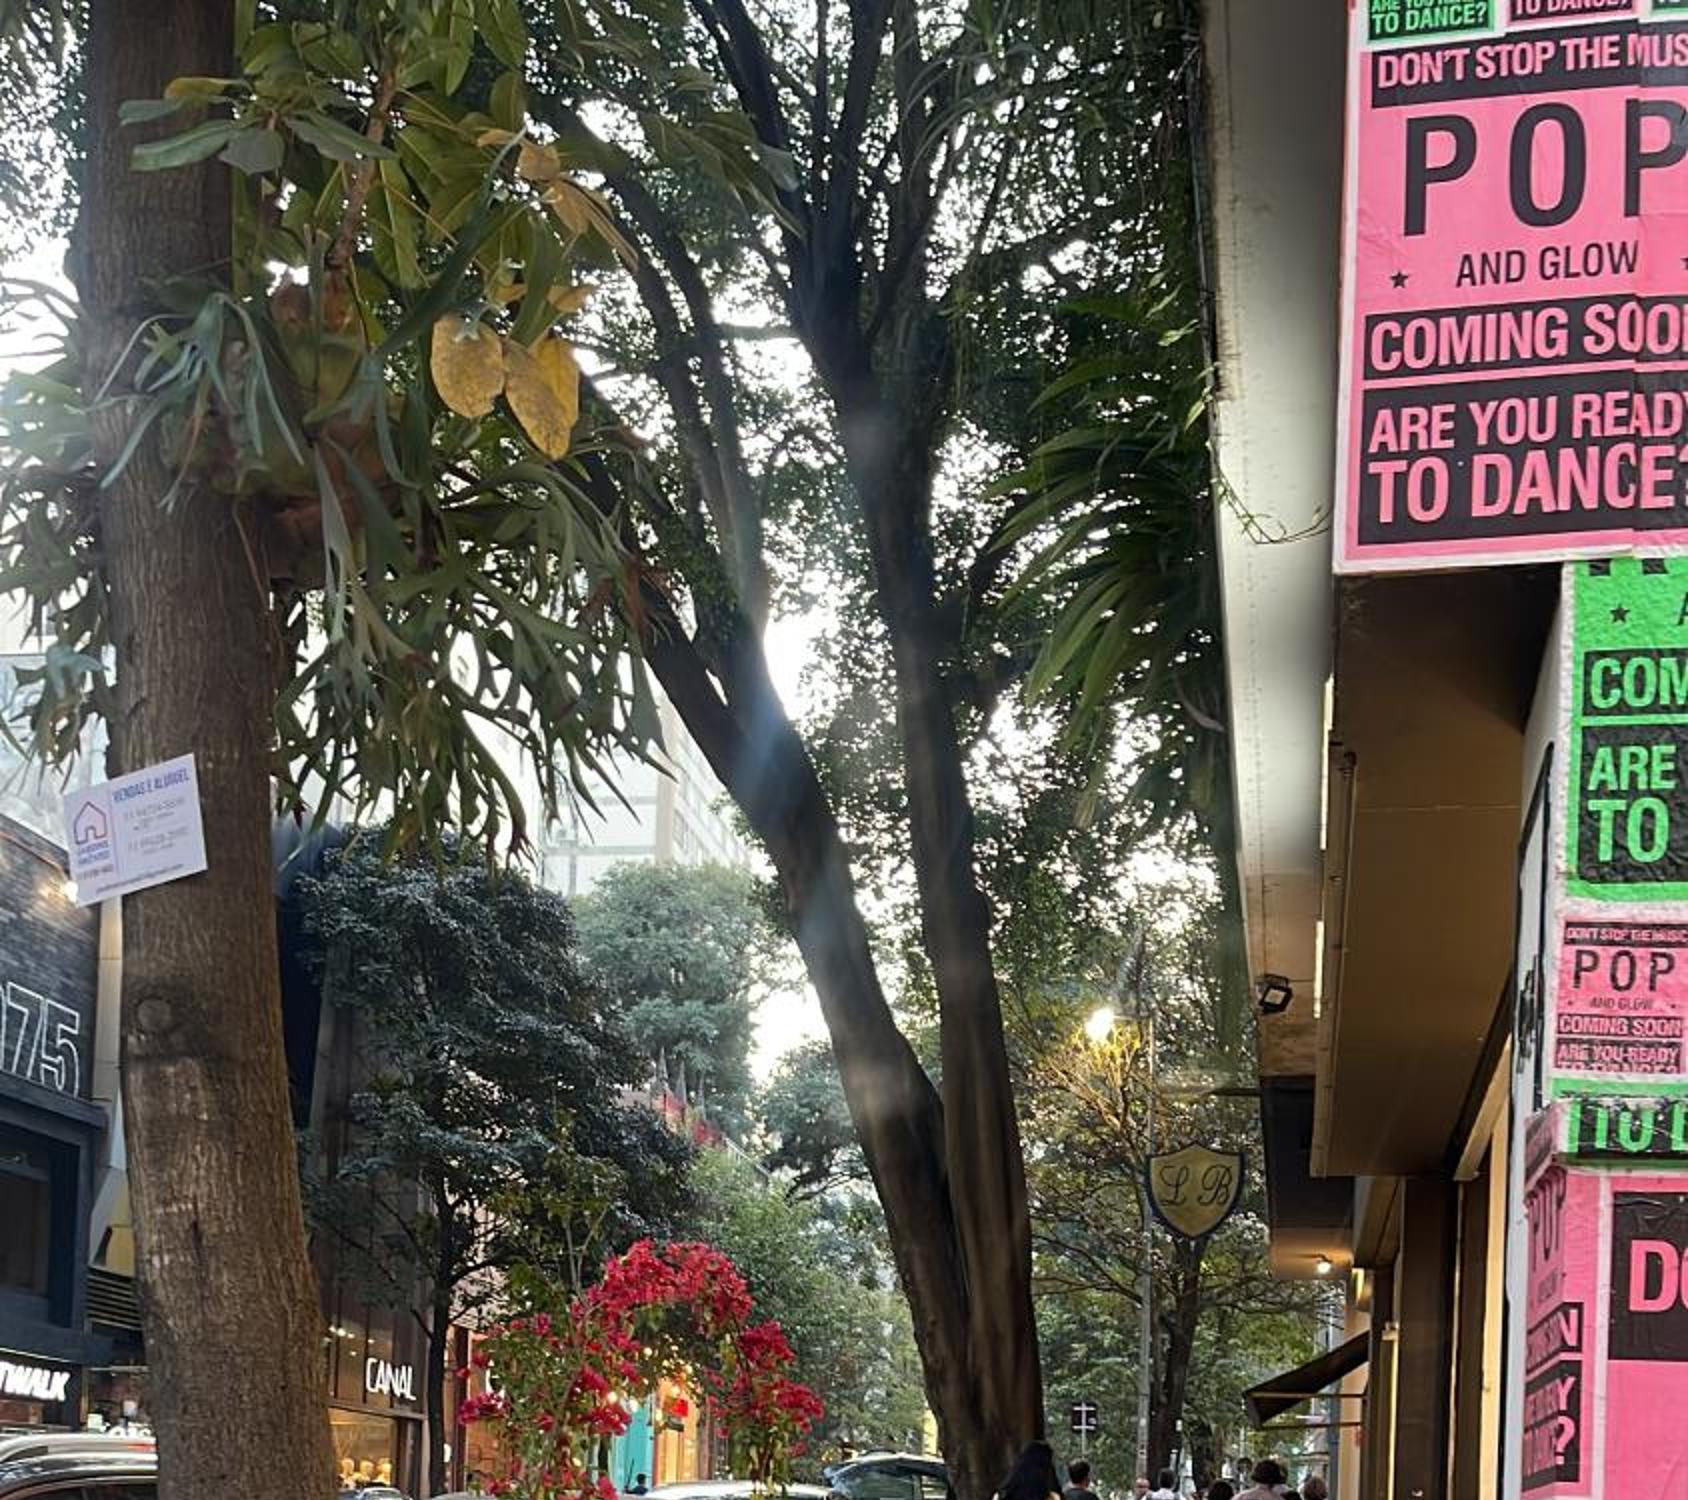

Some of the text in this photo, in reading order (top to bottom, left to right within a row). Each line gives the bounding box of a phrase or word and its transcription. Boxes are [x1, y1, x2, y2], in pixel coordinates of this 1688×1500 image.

[1371, 2, 1487, 35] TO DANCE?
[1377, 47, 1471, 88] DON'T
[1475, 41, 1555, 78] STOP
[1560, 34, 1621, 70] THE
[1403, 97, 1688, 237] POP
[1455, 240, 1639, 288] AND GLOW
[1370, 301, 1688, 371] COMING SOO
[1368, 391, 1688, 454] ARE YOU READ
[1367, 456, 1450, 524] TO
[1587, 745, 1677, 791] ARE
[1586, 796, 1670, 863] TO
[1571, 949, 1676, 992] POP
[0, 981, 80, 1100] 75
[1559, 1014, 1682, 1037] COMING SOON
[1628, 1238, 1688, 1313] D
[365, 1357, 417, 1401] CANAL
